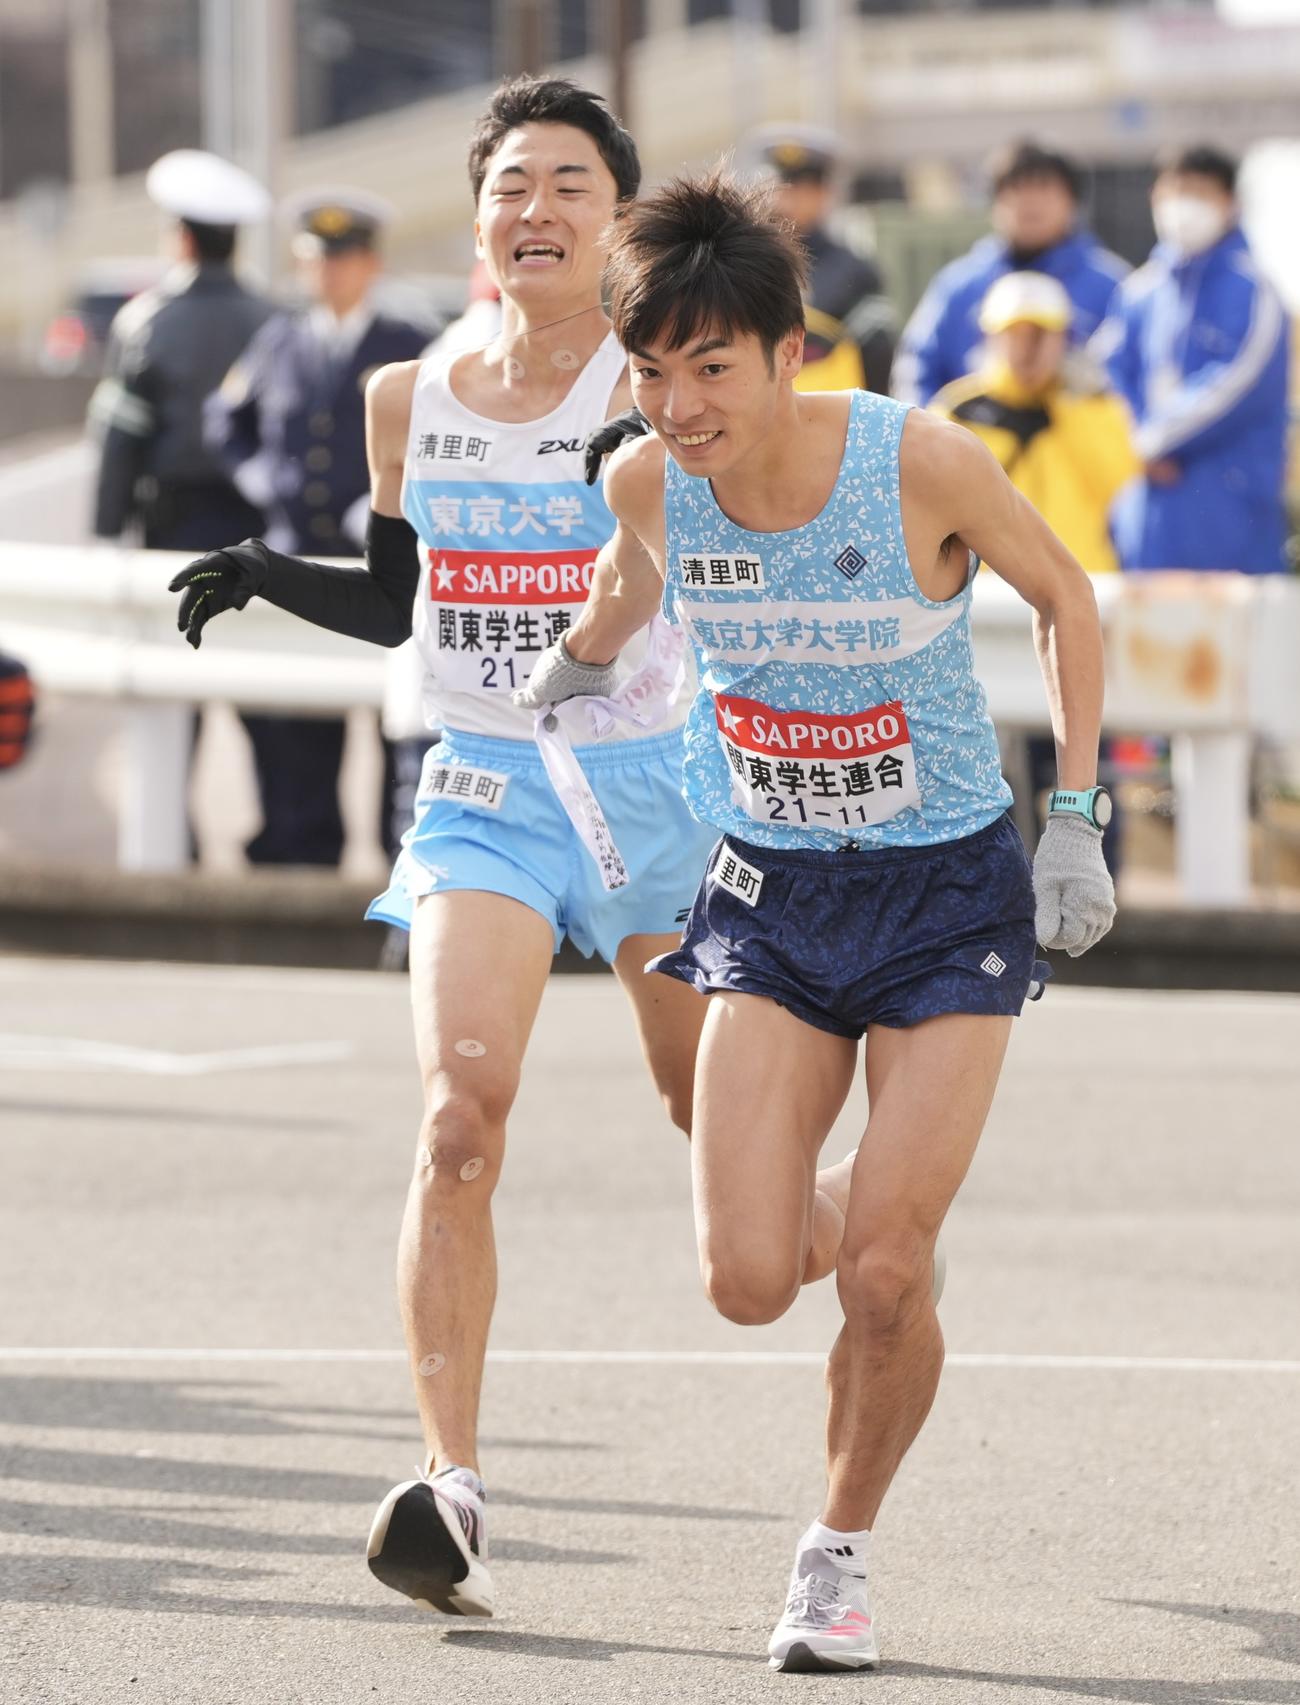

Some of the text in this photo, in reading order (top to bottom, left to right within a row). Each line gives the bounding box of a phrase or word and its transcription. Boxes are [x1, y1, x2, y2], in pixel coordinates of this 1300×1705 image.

[416, 431, 492, 462] 清里町
[427, 494, 585, 537] 東京大学
[682, 557, 760, 585] 清里町
[691, 616, 900, 652] 東京大学大学院
[751, 714, 899, 750] SAPPORO
[425, 766, 504, 804] 清里町
[766, 796, 867, 825] 21-11
